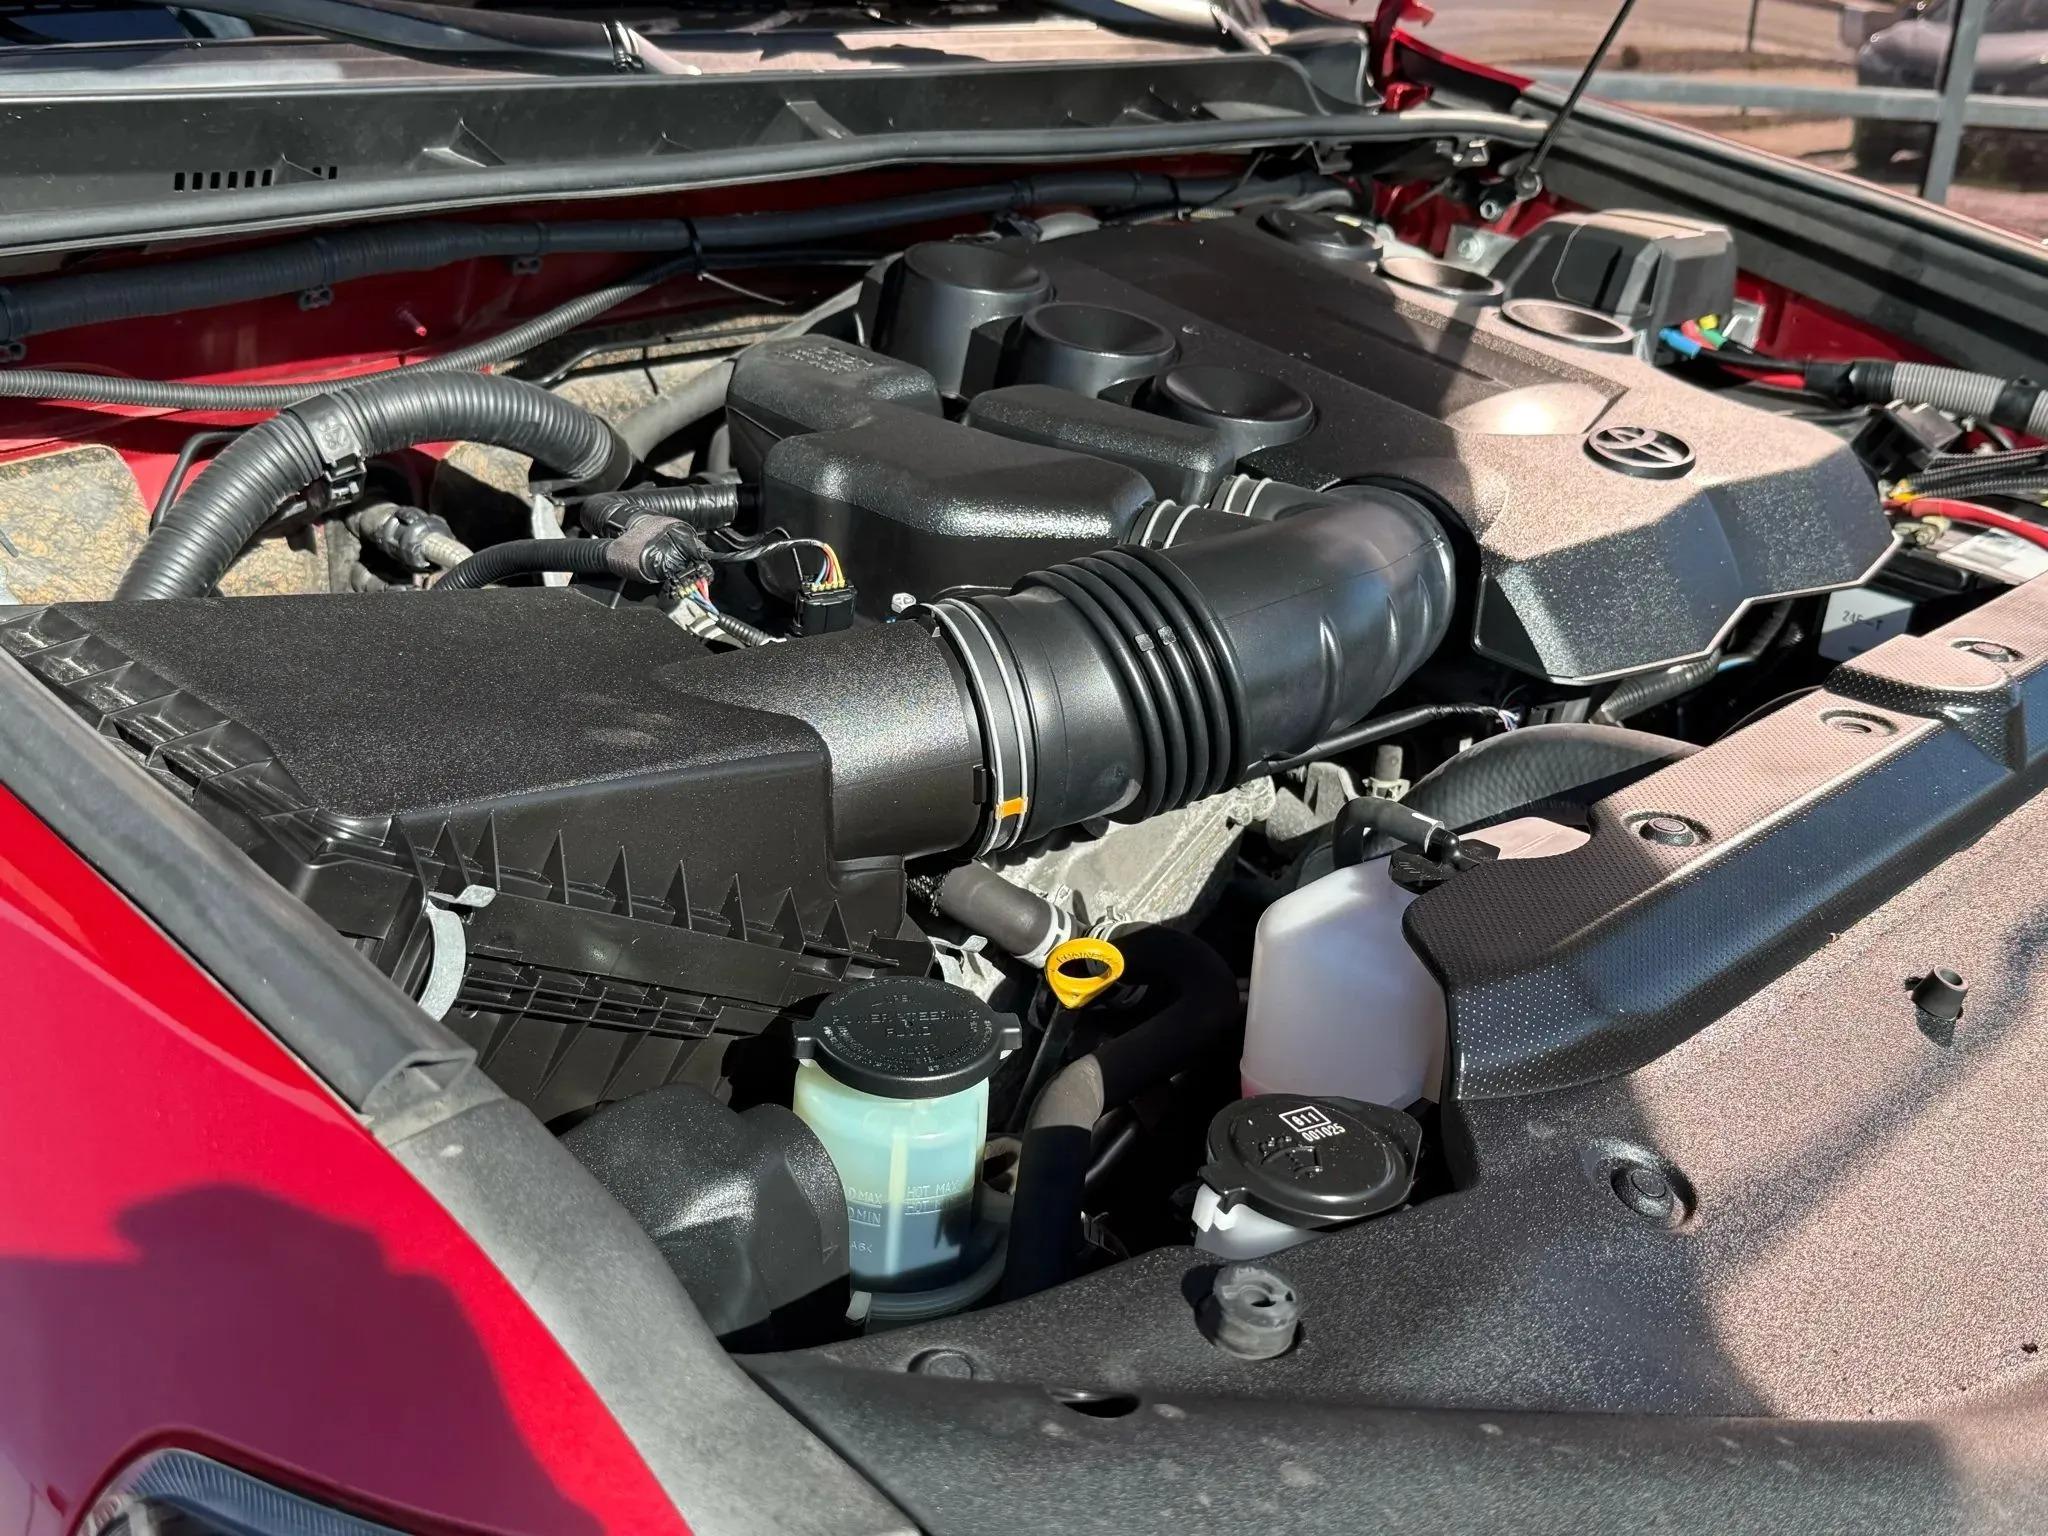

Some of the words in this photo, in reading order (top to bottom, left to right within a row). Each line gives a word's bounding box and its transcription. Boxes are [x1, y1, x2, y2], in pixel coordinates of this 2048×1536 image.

[1301, 1122, 1346, 1142] 001025
[858, 1190, 883, 1205] MAX
[906, 1185, 931, 1198] HOT
[856, 1208, 881, 1225] MIN
